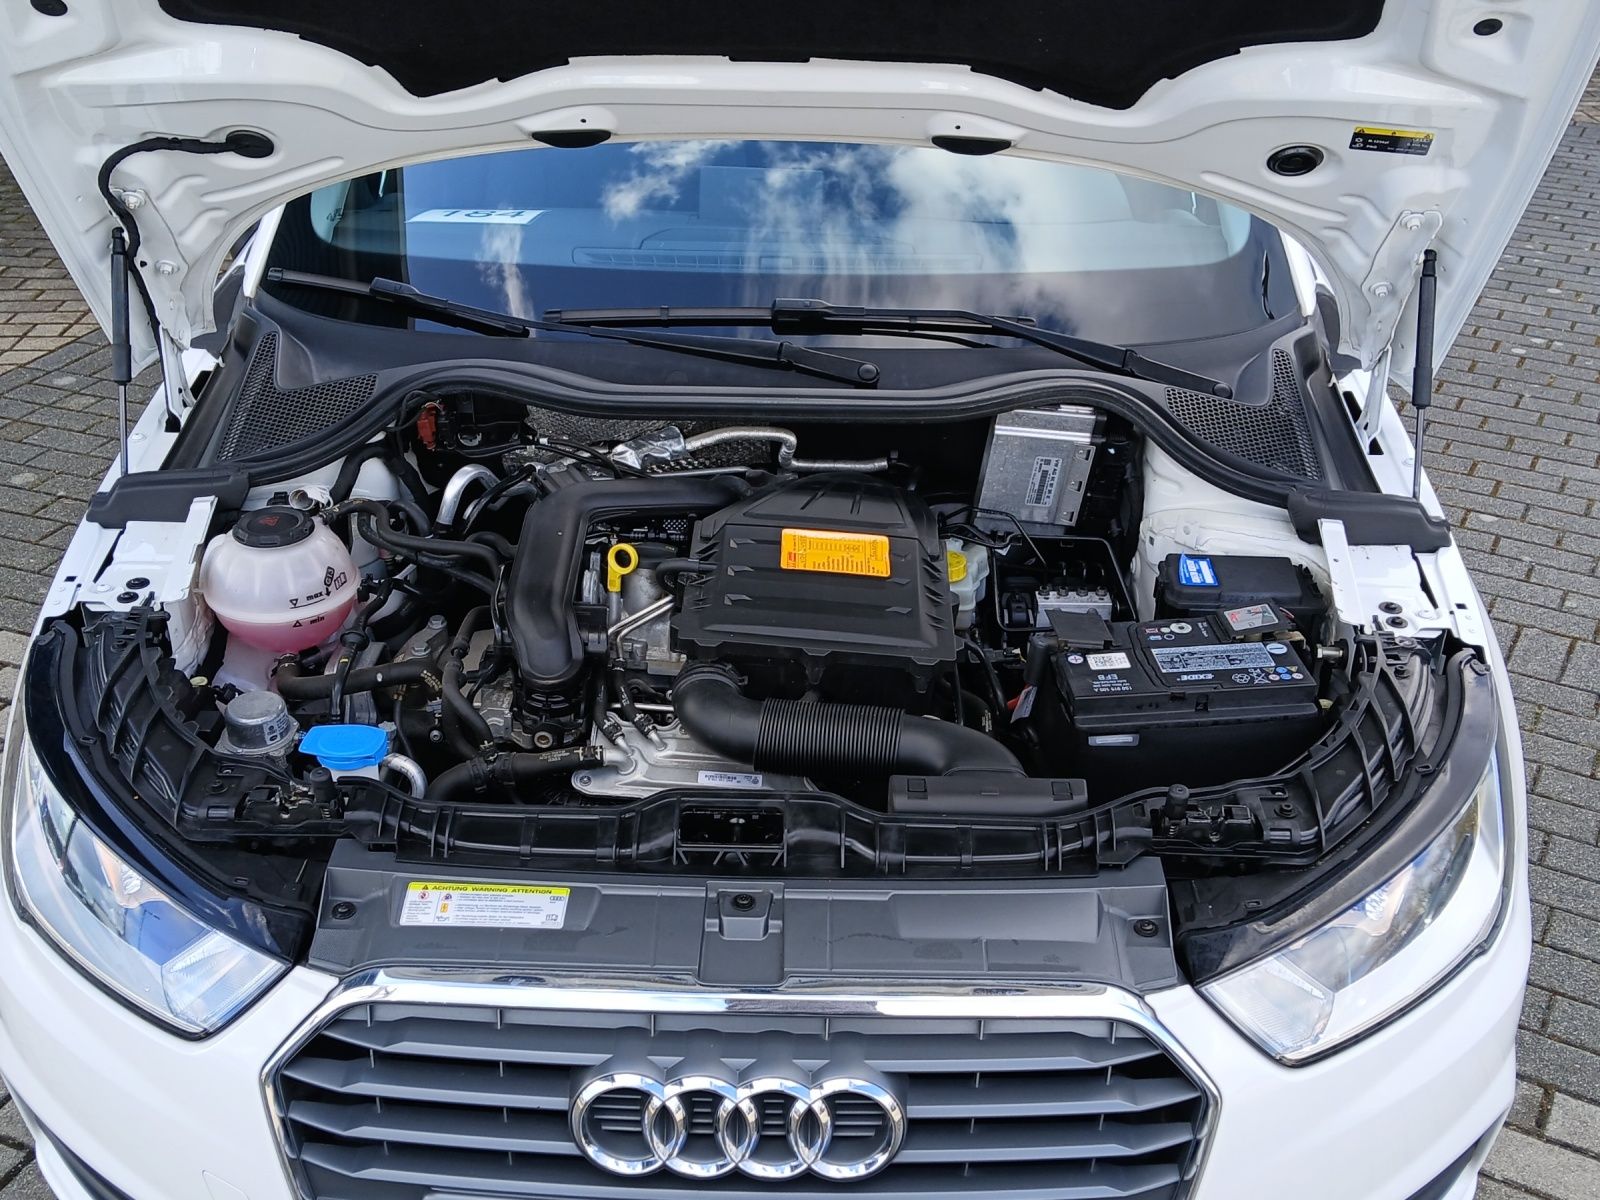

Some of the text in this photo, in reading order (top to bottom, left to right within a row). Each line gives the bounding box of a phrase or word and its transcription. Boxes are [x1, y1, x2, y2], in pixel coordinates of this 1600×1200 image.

[306, 592, 324, 601] max
[310, 616, 325, 625] min
[1097, 673, 1118, 681] EFB
